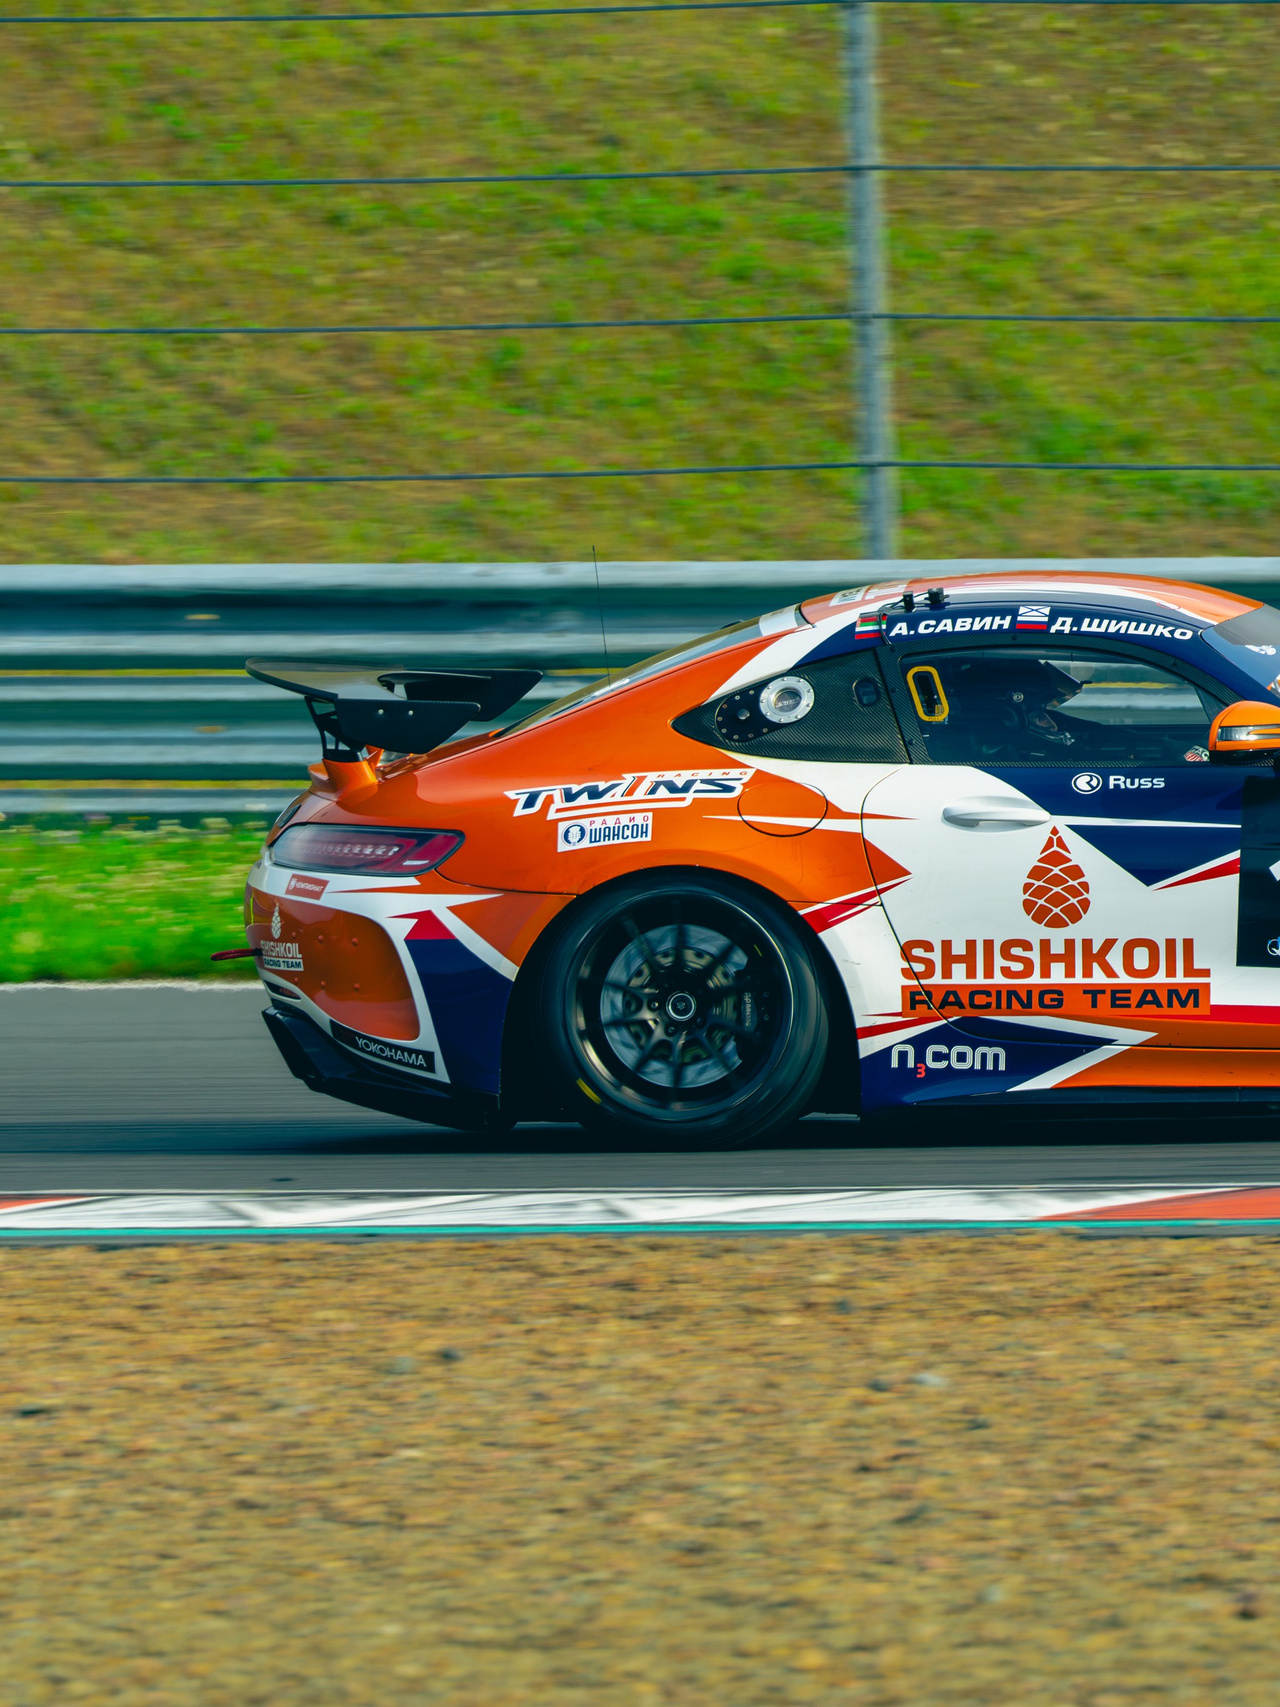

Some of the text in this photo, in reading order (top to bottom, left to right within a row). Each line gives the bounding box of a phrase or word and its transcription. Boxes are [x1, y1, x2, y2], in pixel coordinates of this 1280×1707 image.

[889, 615, 1012, 637] А.САВИН
[1050, 616, 1194, 641] Д.ШИШКО
[657, 771, 748, 779] RACING
[1109, 775, 1165, 789] Russ
[589, 814, 650, 827] РАДИО
[589, 823, 650, 844] ШАНСОН
[283, 961, 302, 969] TEAM
[900, 938, 1211, 980] SHISHKOIL
[909, 988, 1200, 1011] RACING TEAM
[355, 1036, 427, 1067] YOKOHAMA
